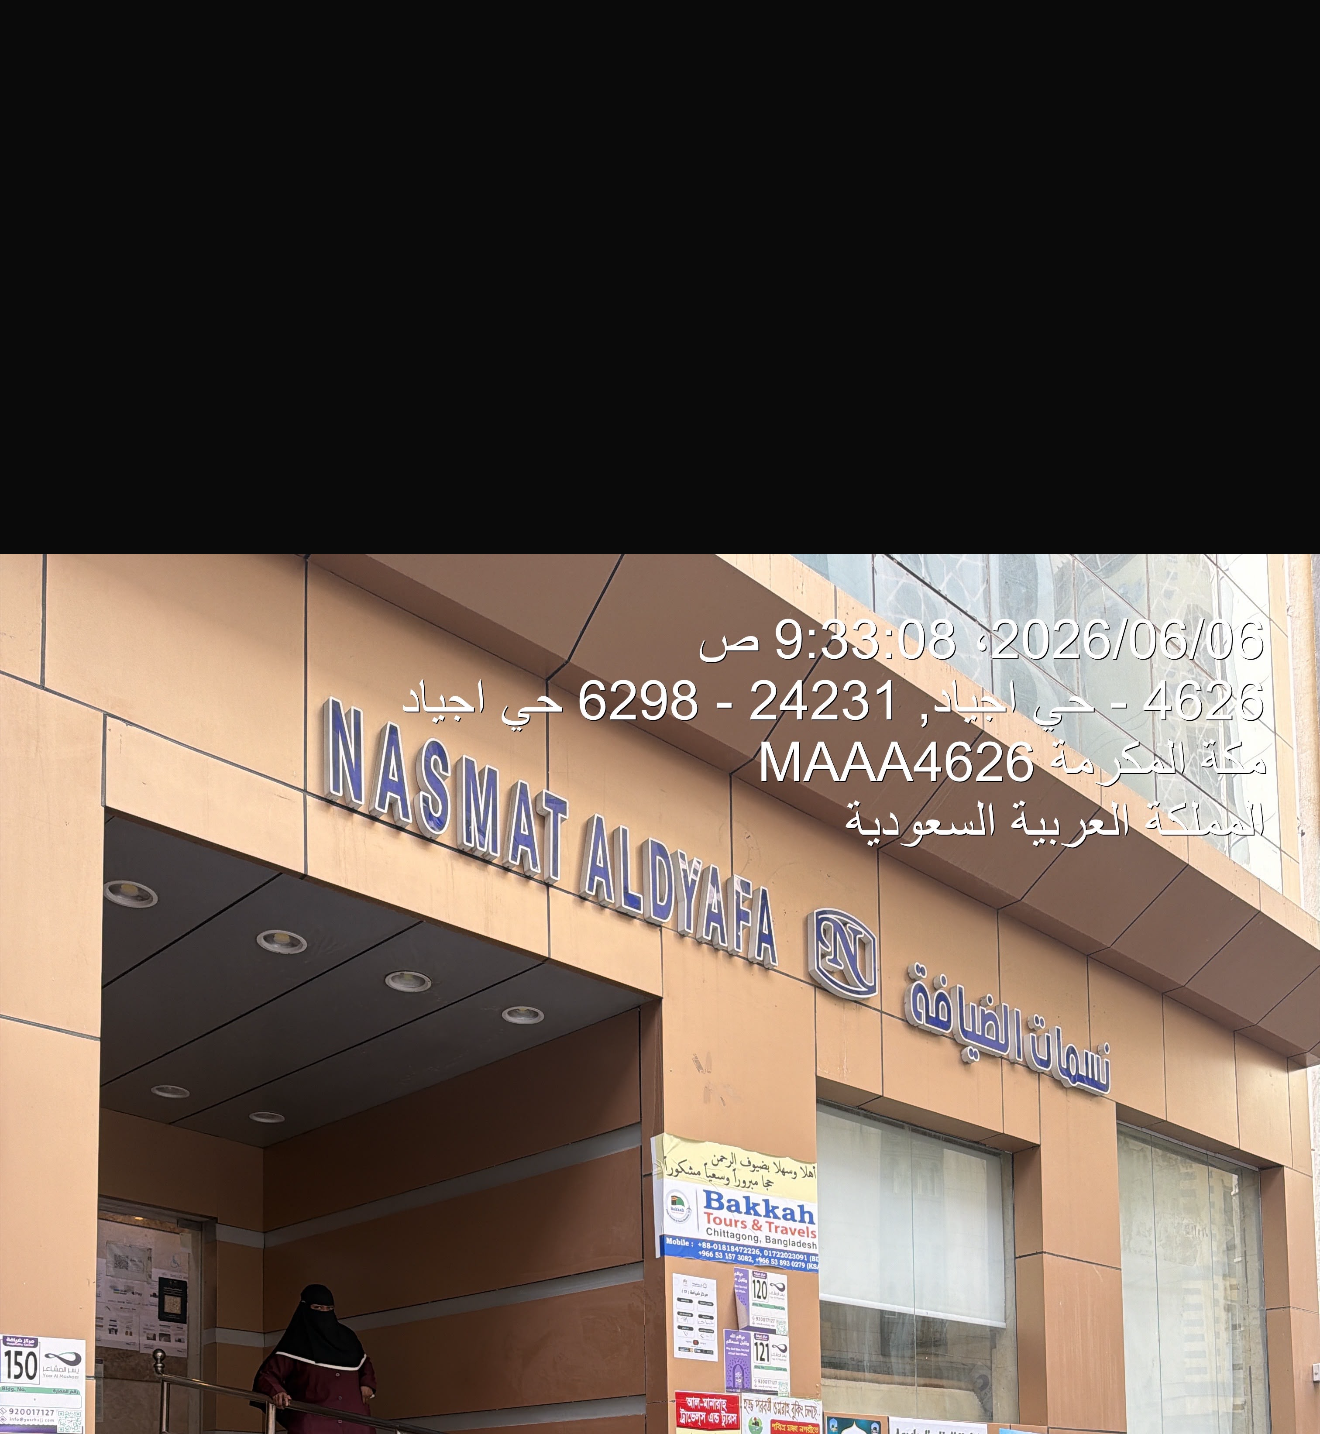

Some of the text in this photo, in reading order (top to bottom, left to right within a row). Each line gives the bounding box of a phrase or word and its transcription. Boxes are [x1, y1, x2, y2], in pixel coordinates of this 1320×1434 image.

[323, 696, 779, 970] NASMAT ALDYAFA
[904, 961, 1112, 1096] نسمات الضيافة
[711, 1152, 817, 1180] أهلا وسهلا بضيوف الرحمن
[761, 1174, 775, 1191] حجا
[702, 1189, 816, 1226] Bakkah
[704, 1211, 817, 1239] Tours & Travels
[665, 1237, 690, 1248] Mobile
[706, 1227, 818, 1250] Chittagong, Bangladesh
[752, 1279, 768, 1300] 120
[4, 1349, 38, 1380] 150
[754, 1341, 770, 1363] 121
[9, 1407, 55, 1416] 920017127
